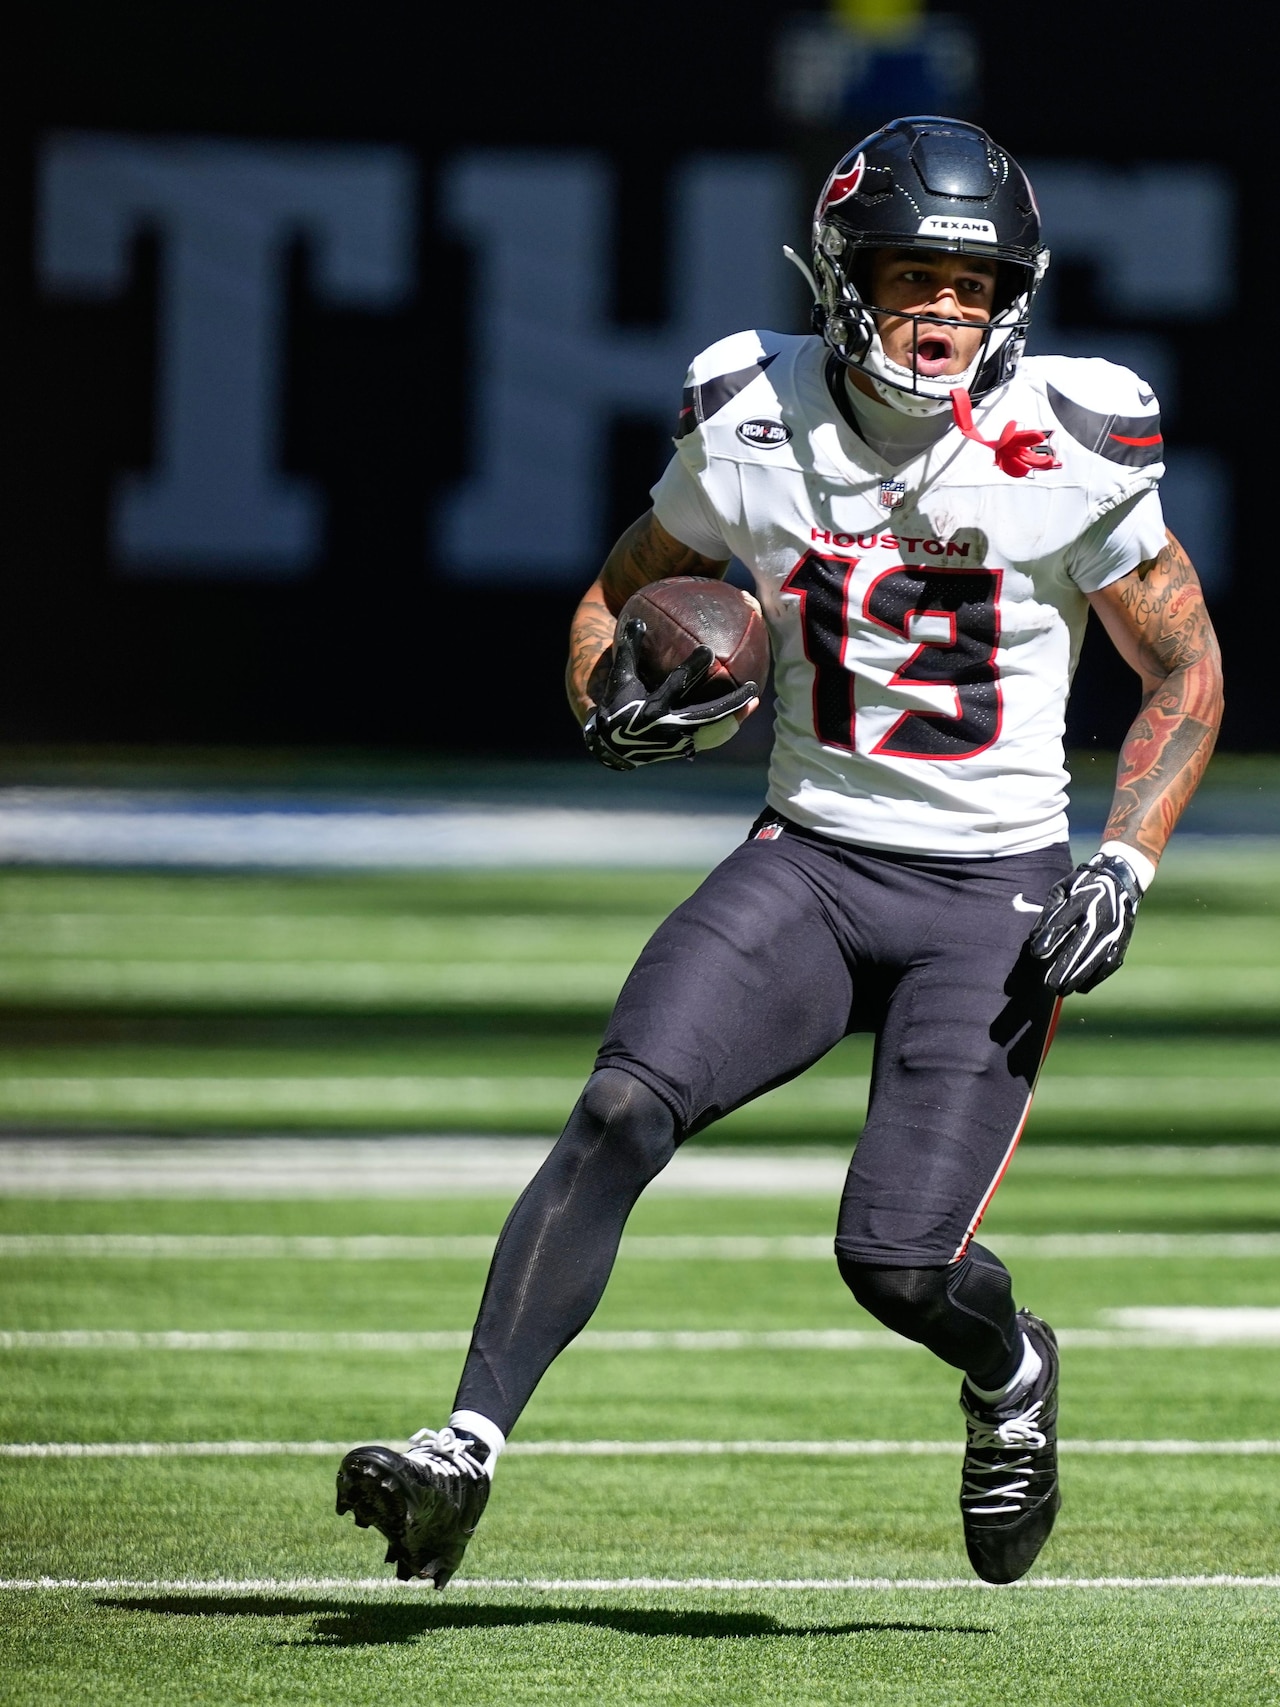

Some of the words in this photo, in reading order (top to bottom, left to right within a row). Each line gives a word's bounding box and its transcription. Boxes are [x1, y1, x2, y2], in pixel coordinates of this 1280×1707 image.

[930, 220, 989, 232] TEXANS
[811, 527, 971, 557] HOUSTON
[780, 548, 1005, 761] 13
